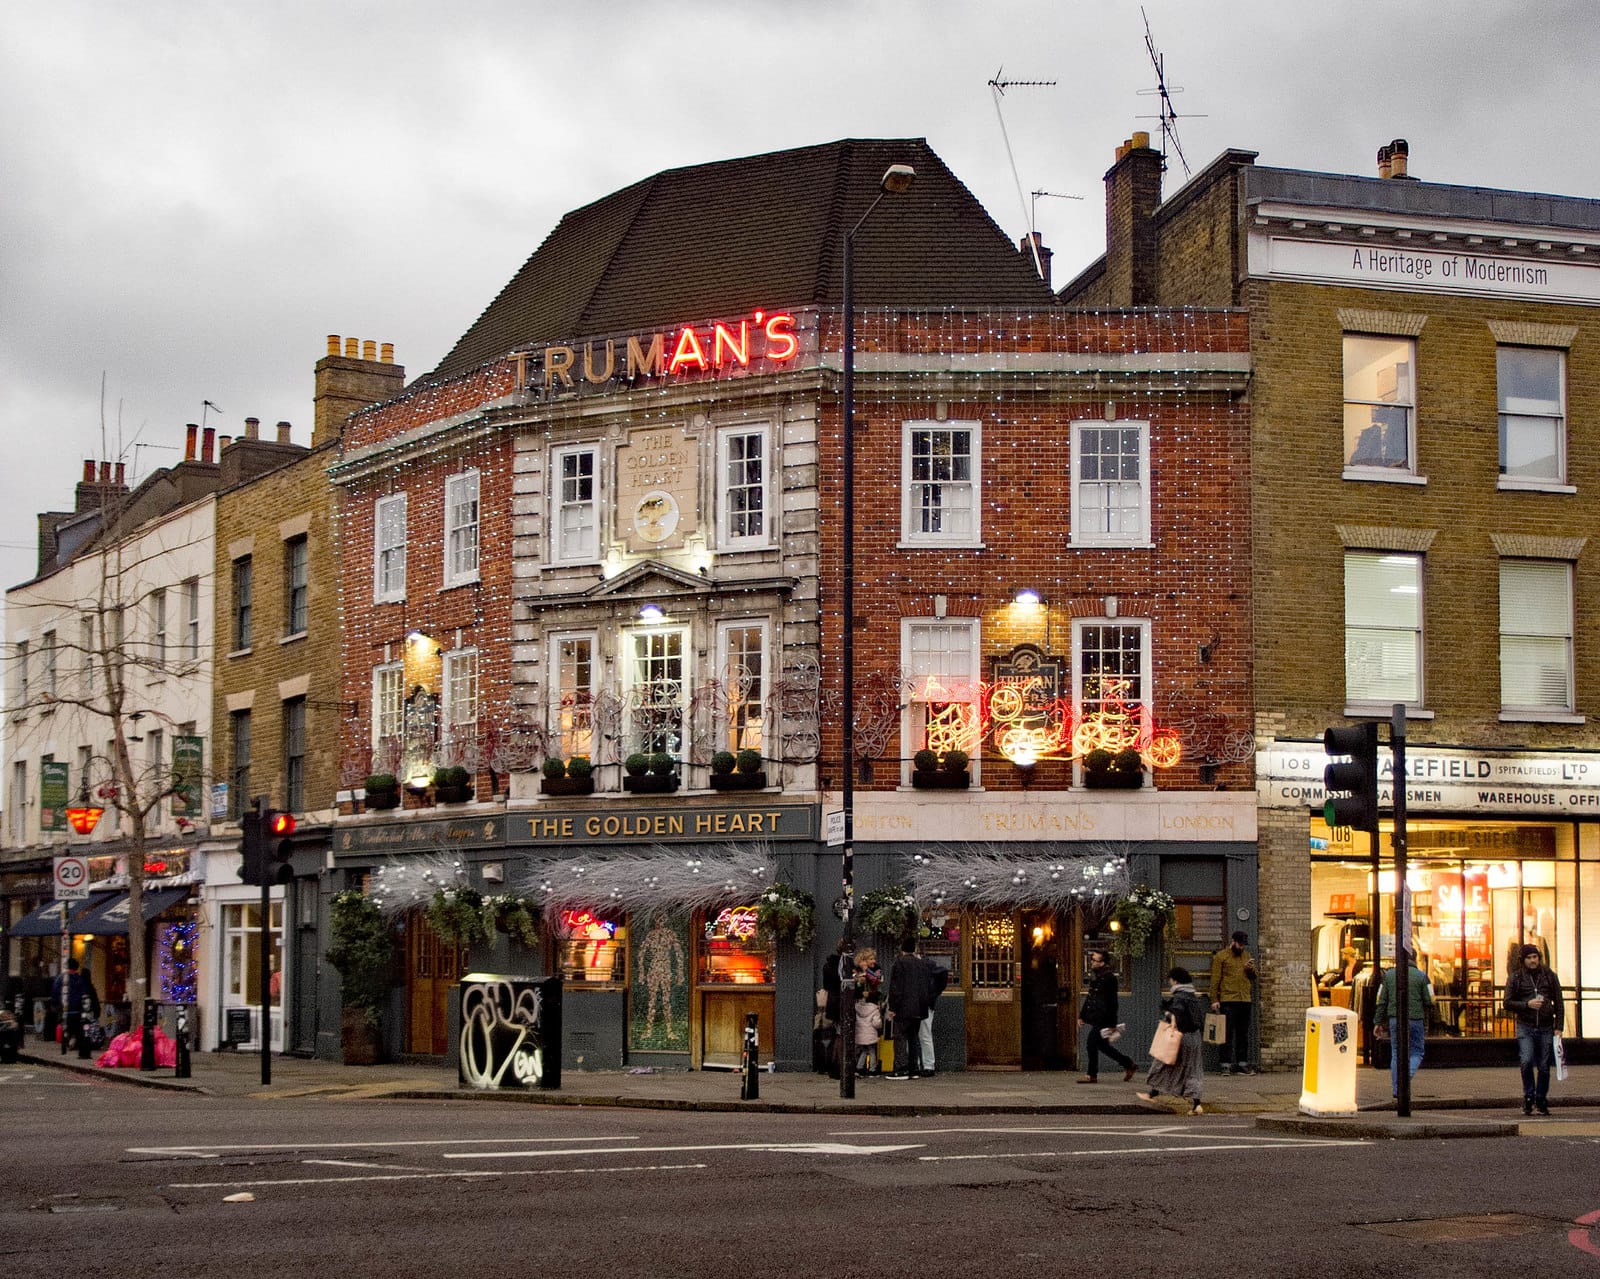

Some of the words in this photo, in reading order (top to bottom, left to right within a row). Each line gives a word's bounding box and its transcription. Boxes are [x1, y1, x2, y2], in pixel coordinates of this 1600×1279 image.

[1353, 249, 1363, 270] A
[1370, 250, 1432, 279] Heritage
[1442, 256, 1458, 277] of
[1465, 258, 1548, 285] Modernism
[507, 309, 799, 392] TRUMAN'S
[1281, 758, 1311, 770] 108
[1376, 757, 1491, 779] AEFIELD
[527, 818, 573, 838] THE
[585, 814, 683, 837] GOLDEN
[695, 812, 782, 834] HEART
[980, 813, 1096, 832] TRUMAN'S
[1162, 815, 1234, 830] LONDON
[1330, 827, 1351, 842] 108
[61, 867, 81, 879] 20
[57, 889, 86, 897] ZONE
[1438, 884, 1484, 911] SALE
